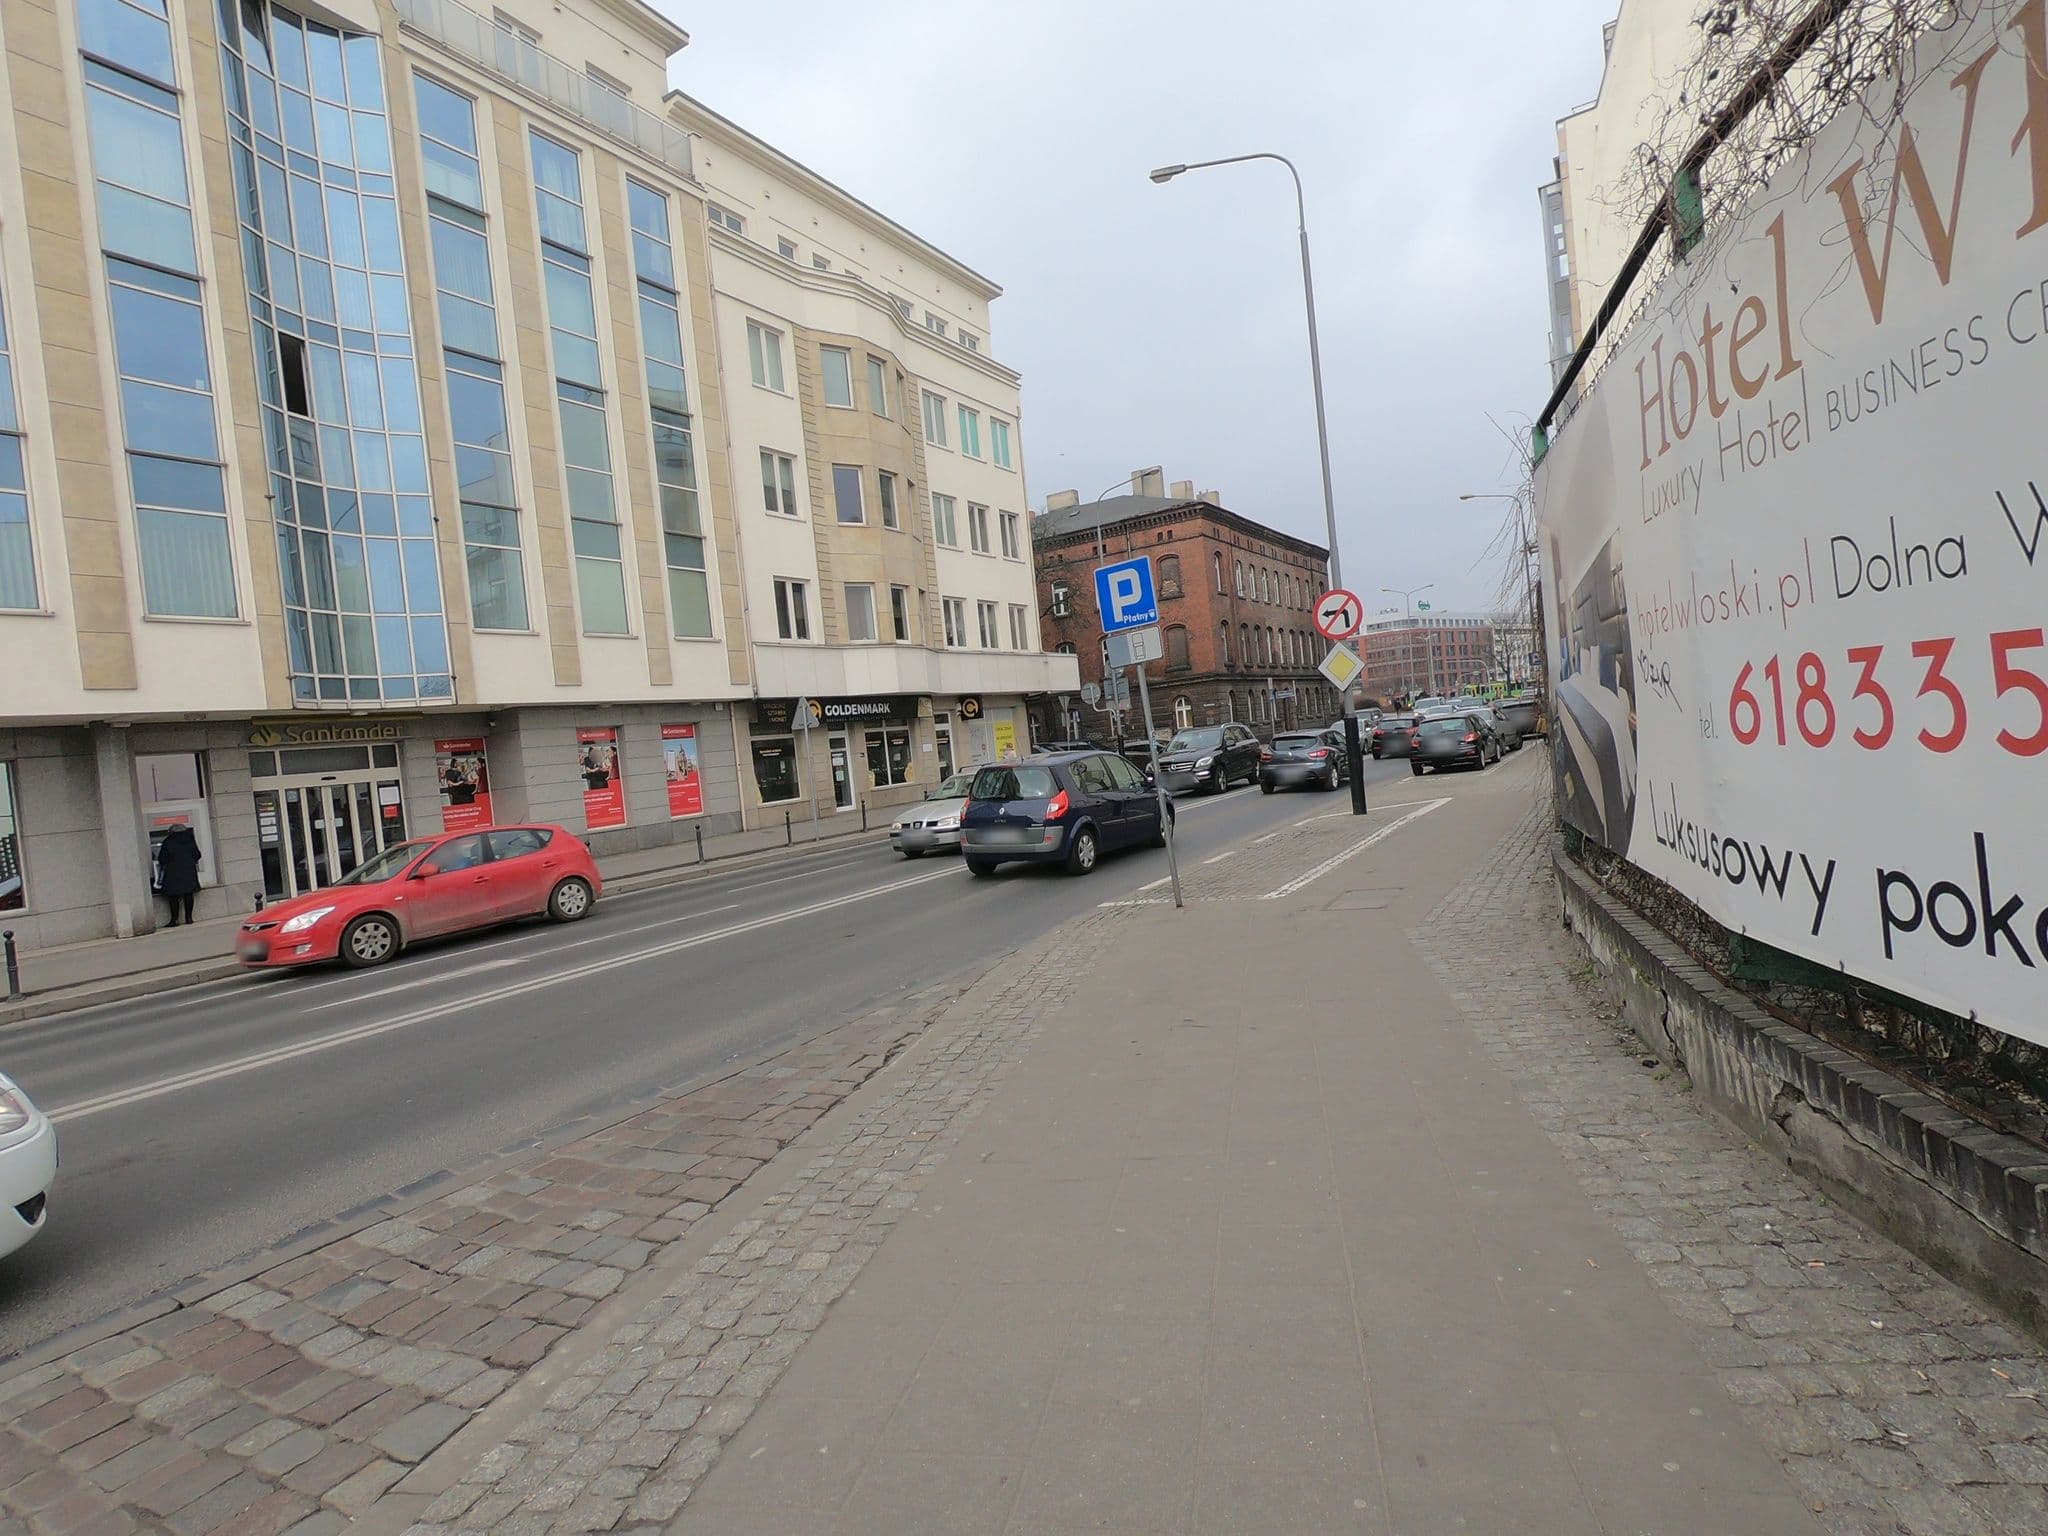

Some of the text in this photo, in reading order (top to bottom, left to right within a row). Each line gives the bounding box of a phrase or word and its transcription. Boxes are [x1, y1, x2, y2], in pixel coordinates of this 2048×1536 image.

[1633, 209, 1803, 471] Hotel
[1640, 458, 1703, 524] Luxury
[1717, 367, 1811, 481] Hotel
[1826, 315, 1989, 432] BUSINESS
[1108, 568, 1143, 623] P
[1634, 537, 1815, 638] hotelwloski.pl
[1830, 516, 1968, 600] Dolna
[286, 724, 402, 745] Santander
[824, 703, 891, 717] GOLDENMARK
[1698, 702, 1719, 740] tel.
[1649, 779, 2048, 969] Luksusowy pok
